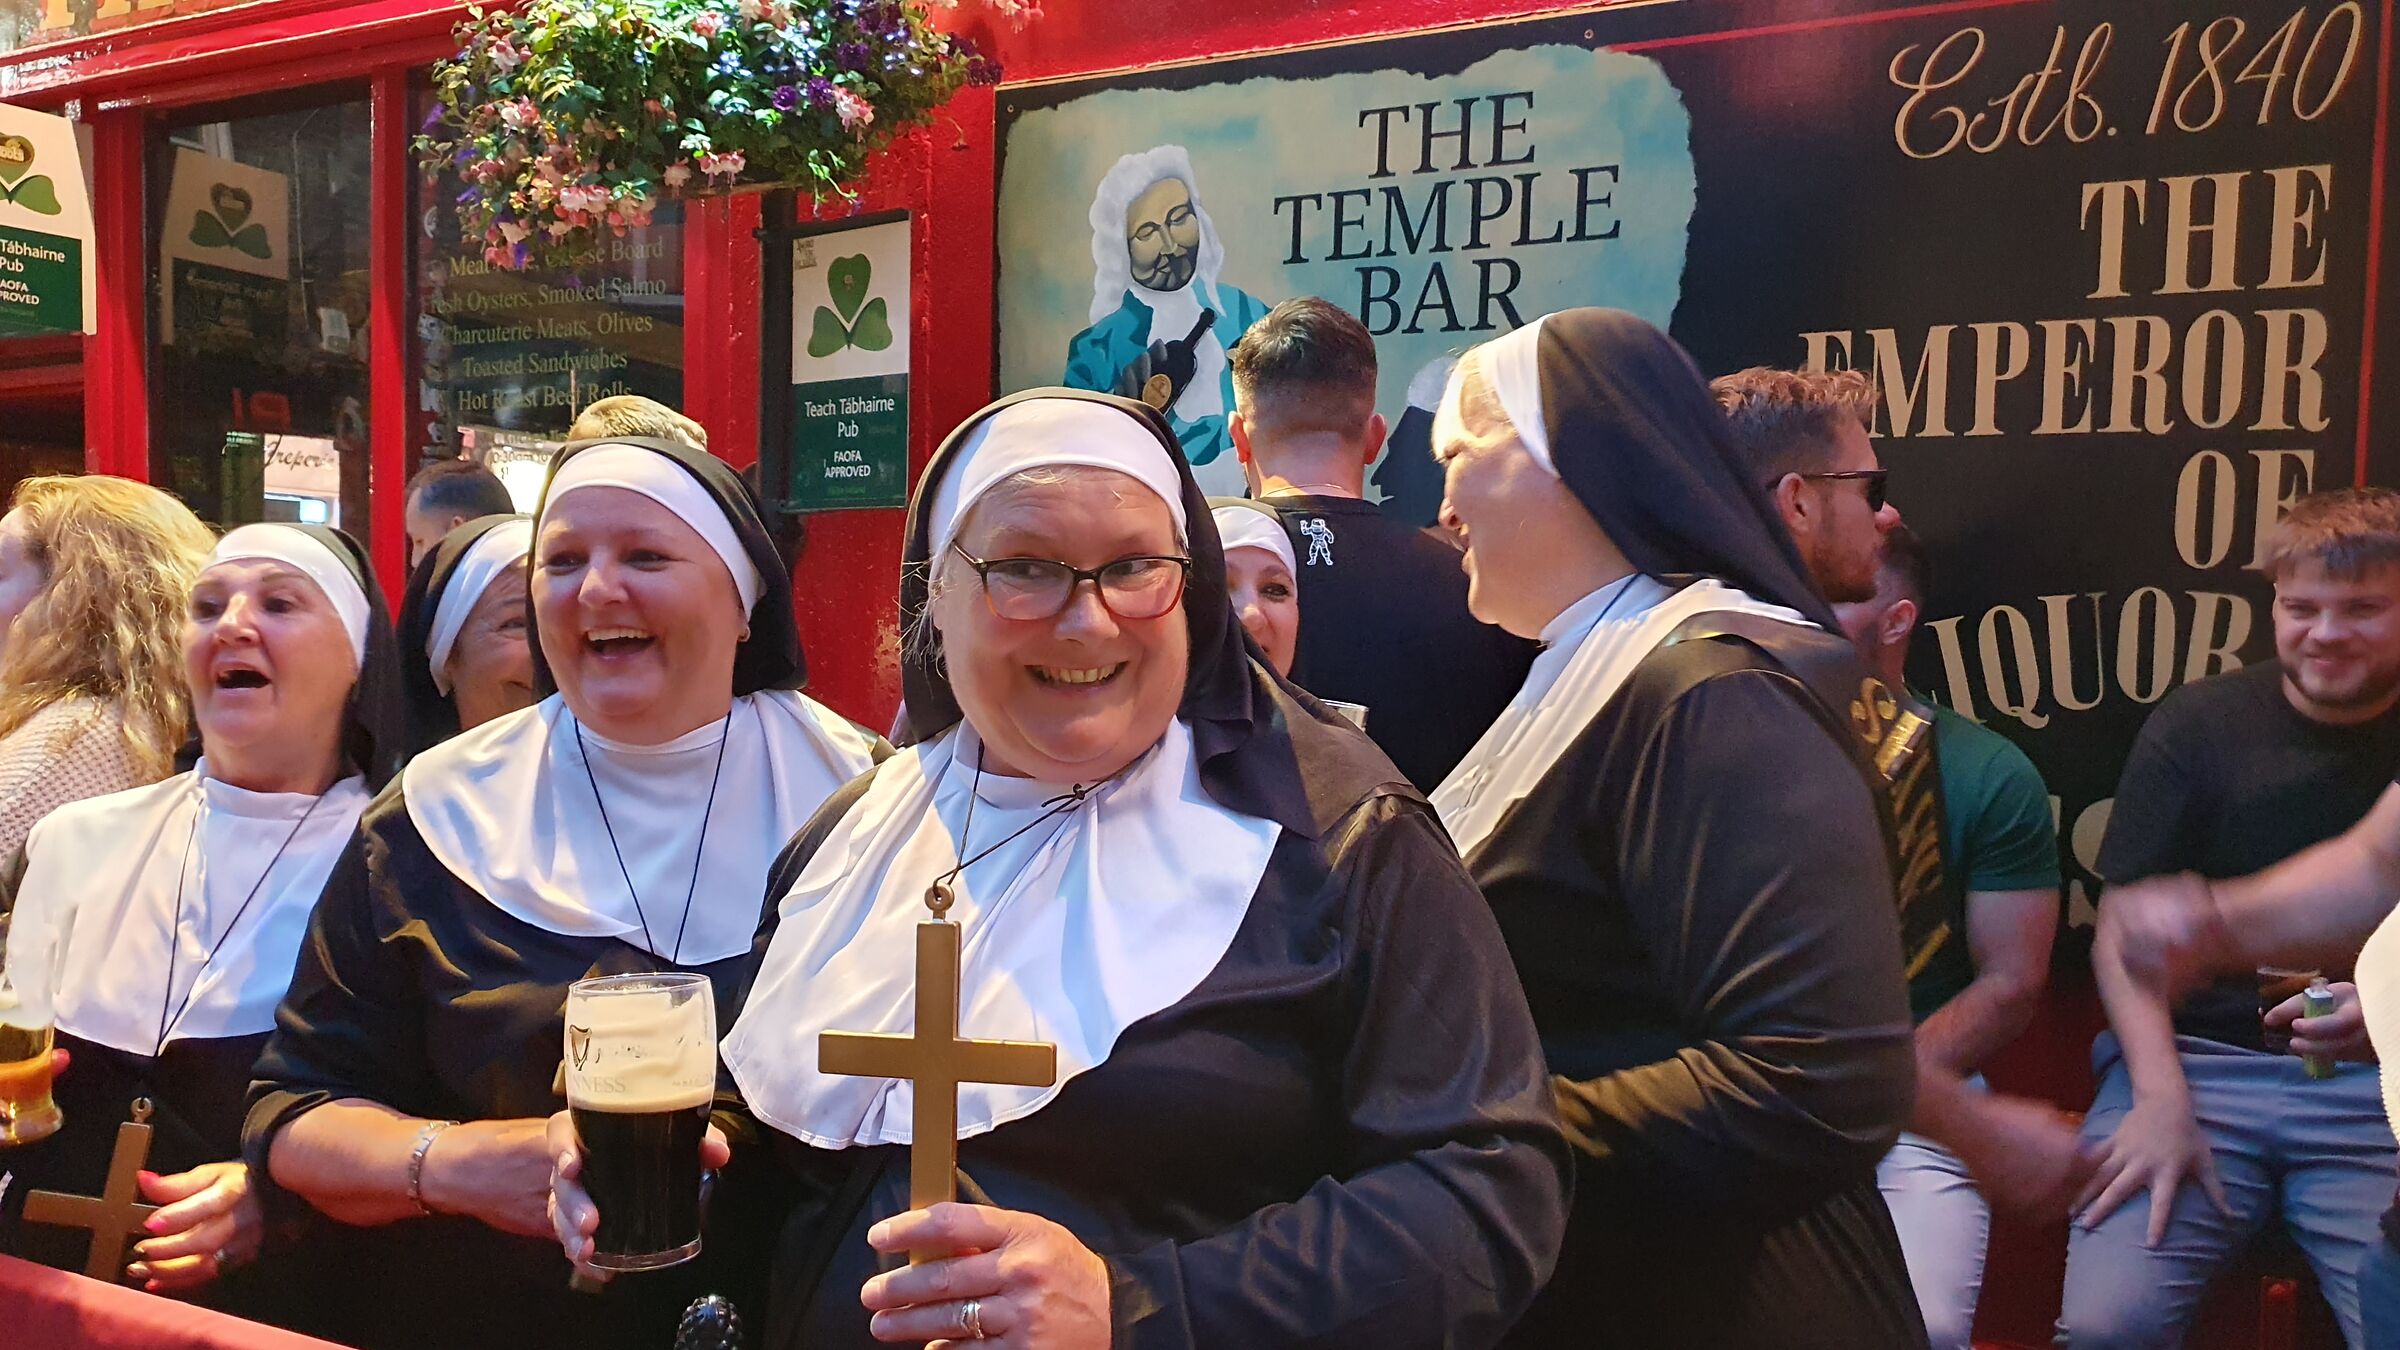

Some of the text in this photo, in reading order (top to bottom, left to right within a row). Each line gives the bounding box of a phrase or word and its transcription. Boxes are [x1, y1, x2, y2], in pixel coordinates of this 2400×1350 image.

[1888, 1, 2362, 159] Estb. 1840
[1358, 91, 1535, 179] THE
[1274, 164, 1620, 265] TEMPLE
[2080, 163, 2332, 299] THE
[0, 239, 65, 263] Tábhairne
[611, 239, 663, 263] Board
[0, 256, 24, 272] Pub
[0, 278, 29, 292] AOFA
[1355, 258, 1525, 335] BAR
[467, 289, 533, 315] Oysters,
[538, 281, 605, 305] Smoked
[597, 312, 653, 335] Olives
[462, 347, 628, 378] Toasted Sandwiches
[458, 389, 488, 411] Hot
[805, 396, 895, 417] Teach Tábhairne
[837, 420, 859, 437] Pub
[833, 450, 862, 463] FAOFA
[824, 465, 871, 478] APPROVED
[1924, 586, 2253, 729] IQUOR
